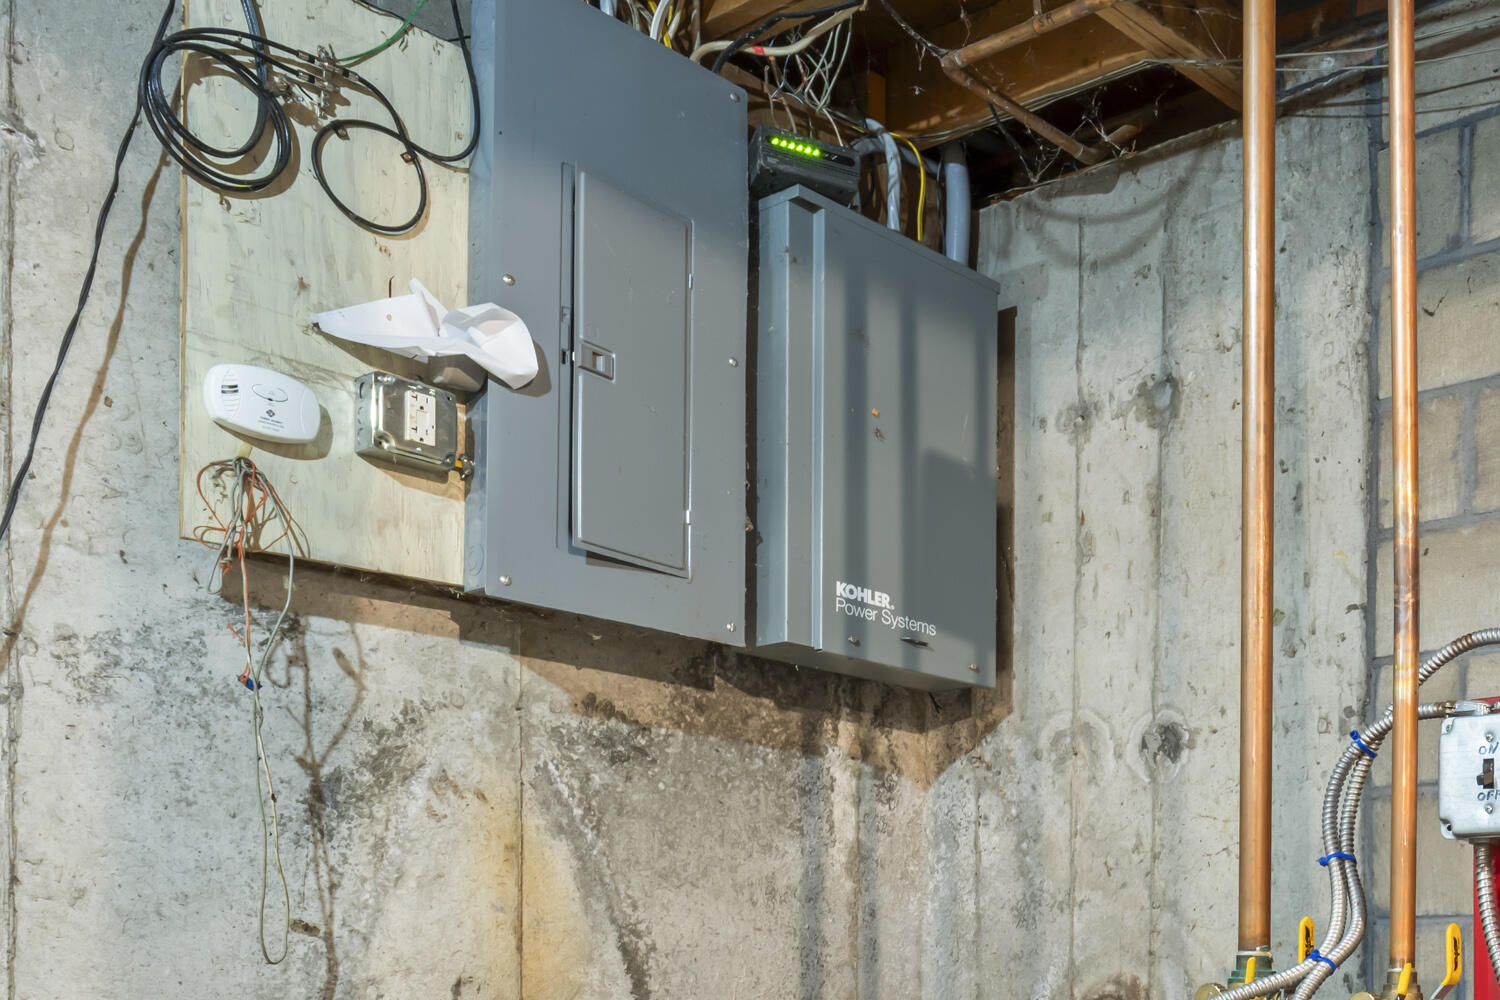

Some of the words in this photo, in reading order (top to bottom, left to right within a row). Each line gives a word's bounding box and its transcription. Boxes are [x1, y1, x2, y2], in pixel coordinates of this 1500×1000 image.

[835, 597, 878, 621] Power
[881, 609, 937, 636] Systems
[1478, 741, 1499, 756] ON
